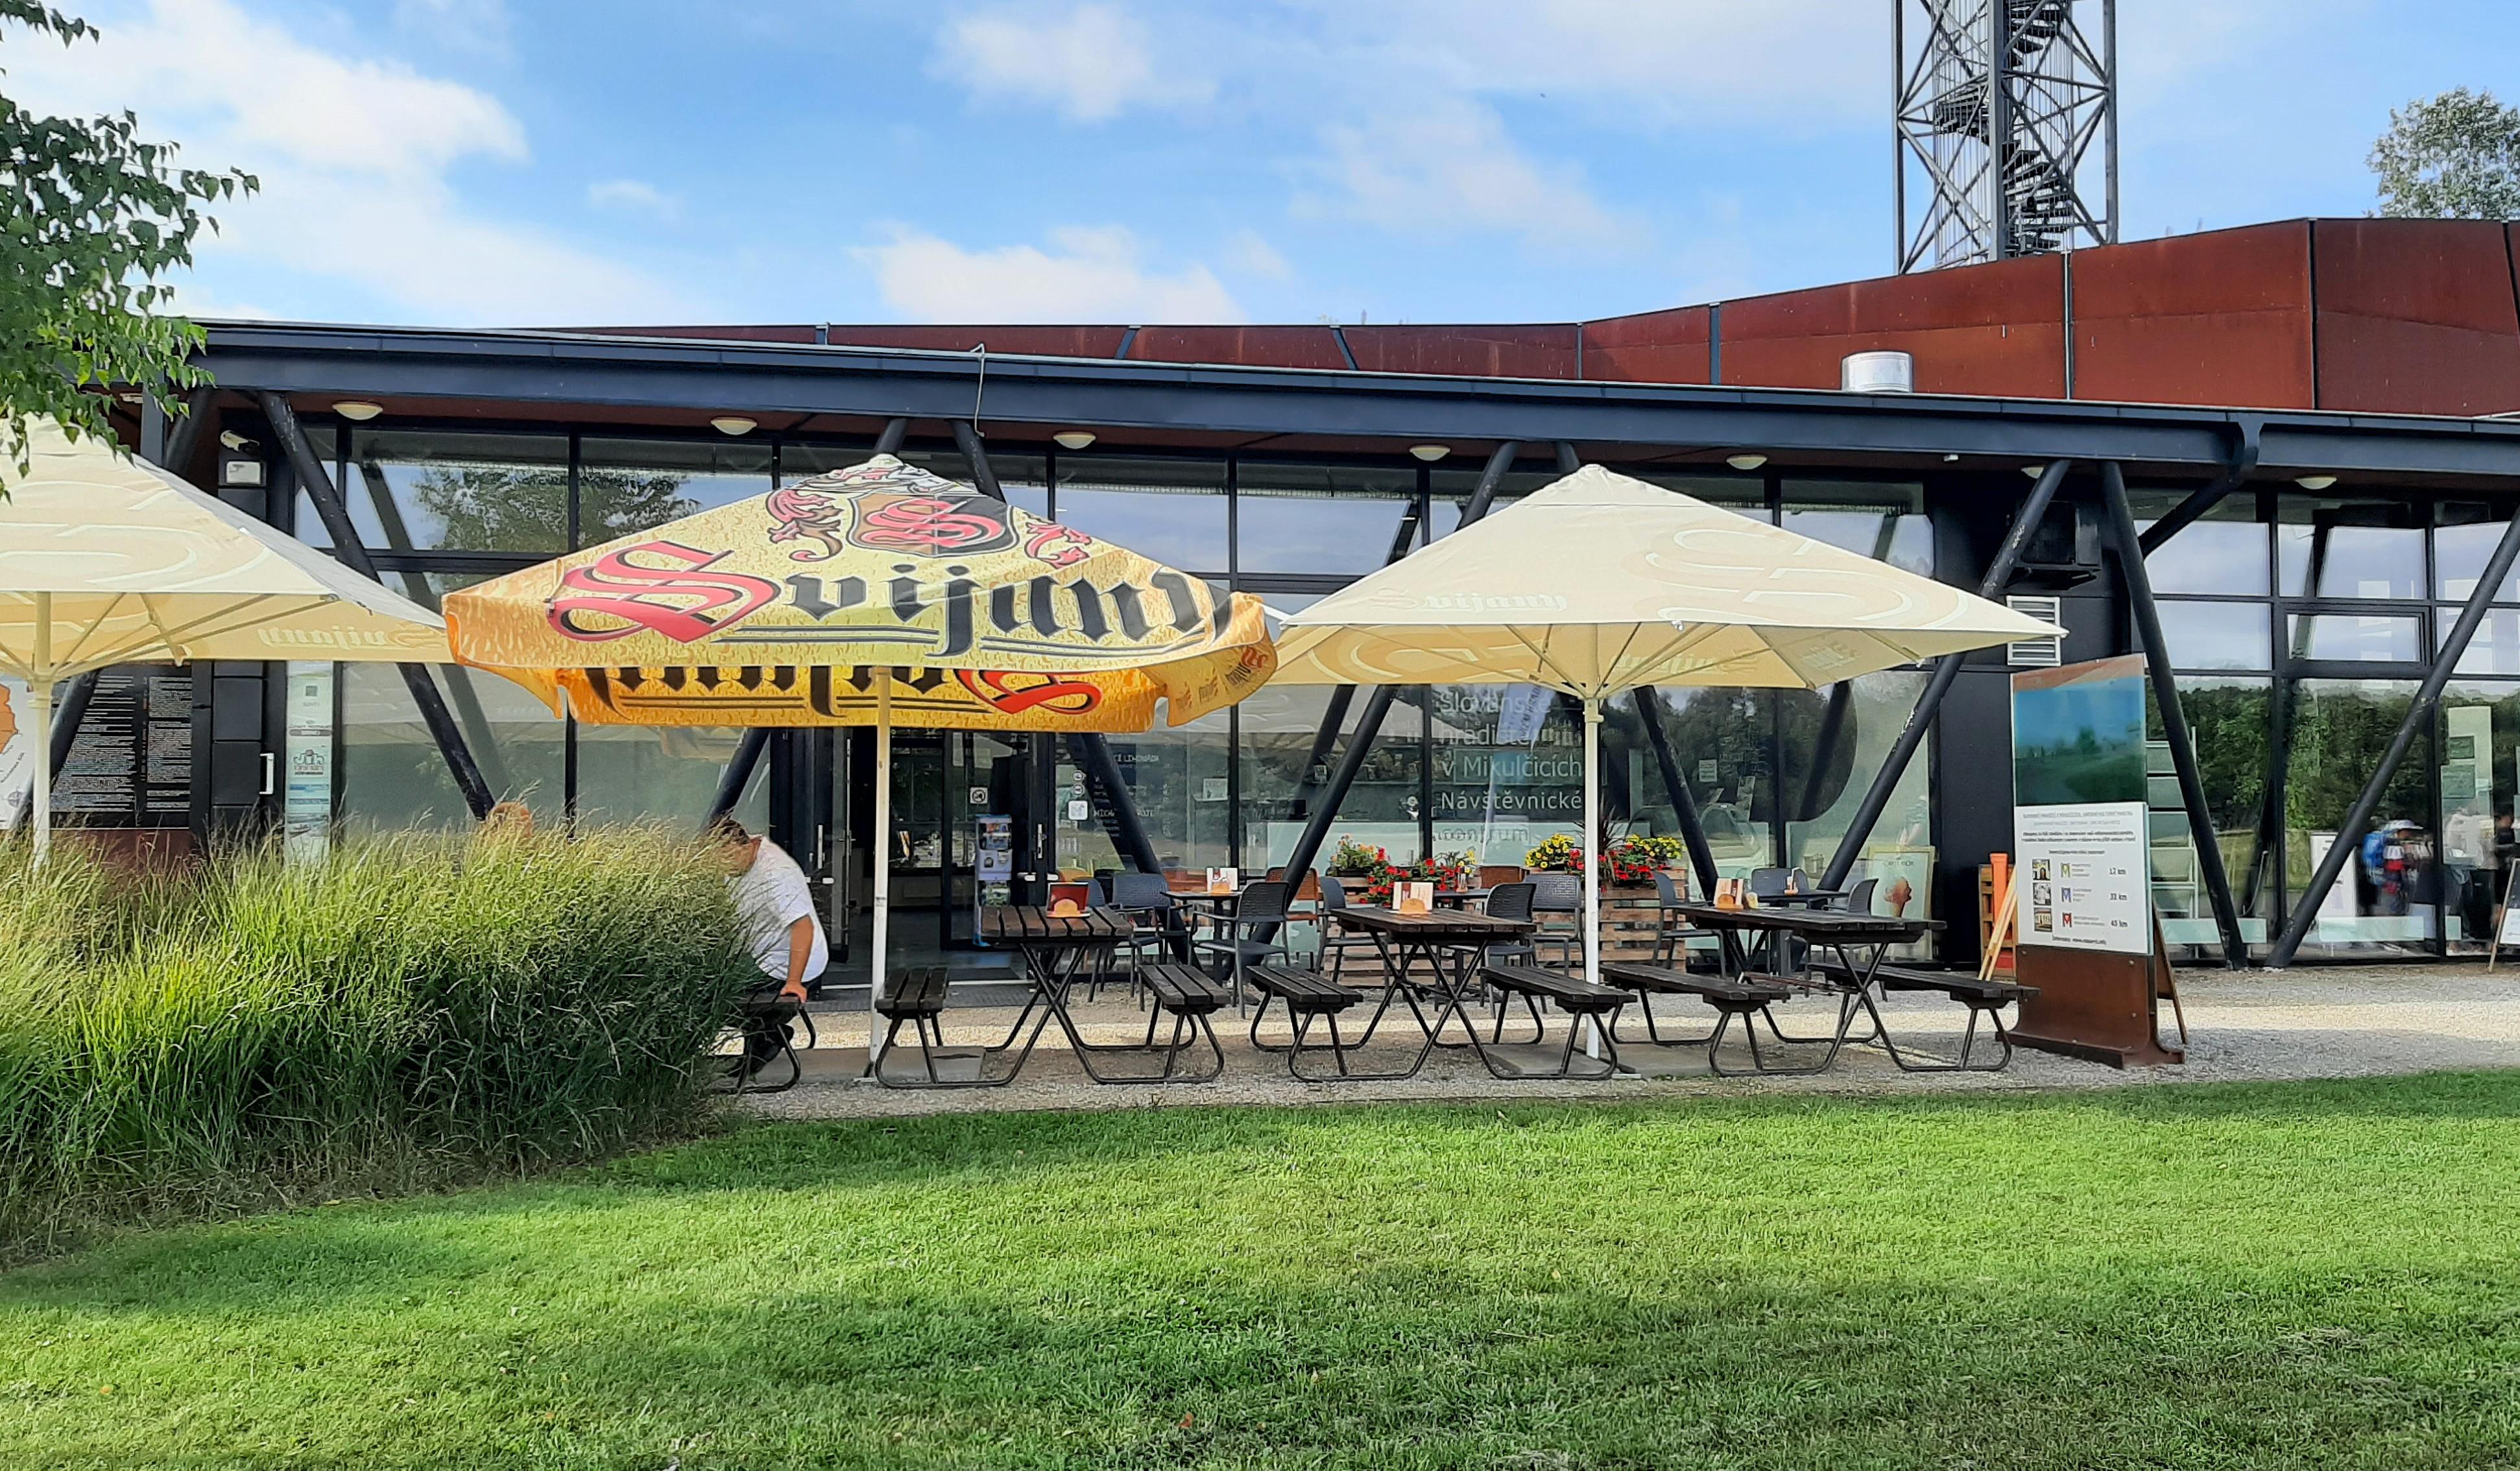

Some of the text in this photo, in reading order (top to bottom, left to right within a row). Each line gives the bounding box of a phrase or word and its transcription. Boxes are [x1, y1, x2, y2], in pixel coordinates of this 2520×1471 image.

[546, 540, 1232, 656] Svijany
[1463, 753, 1581, 777] Mikulčicích
[1441, 790, 1582, 809] Návštěvnické
